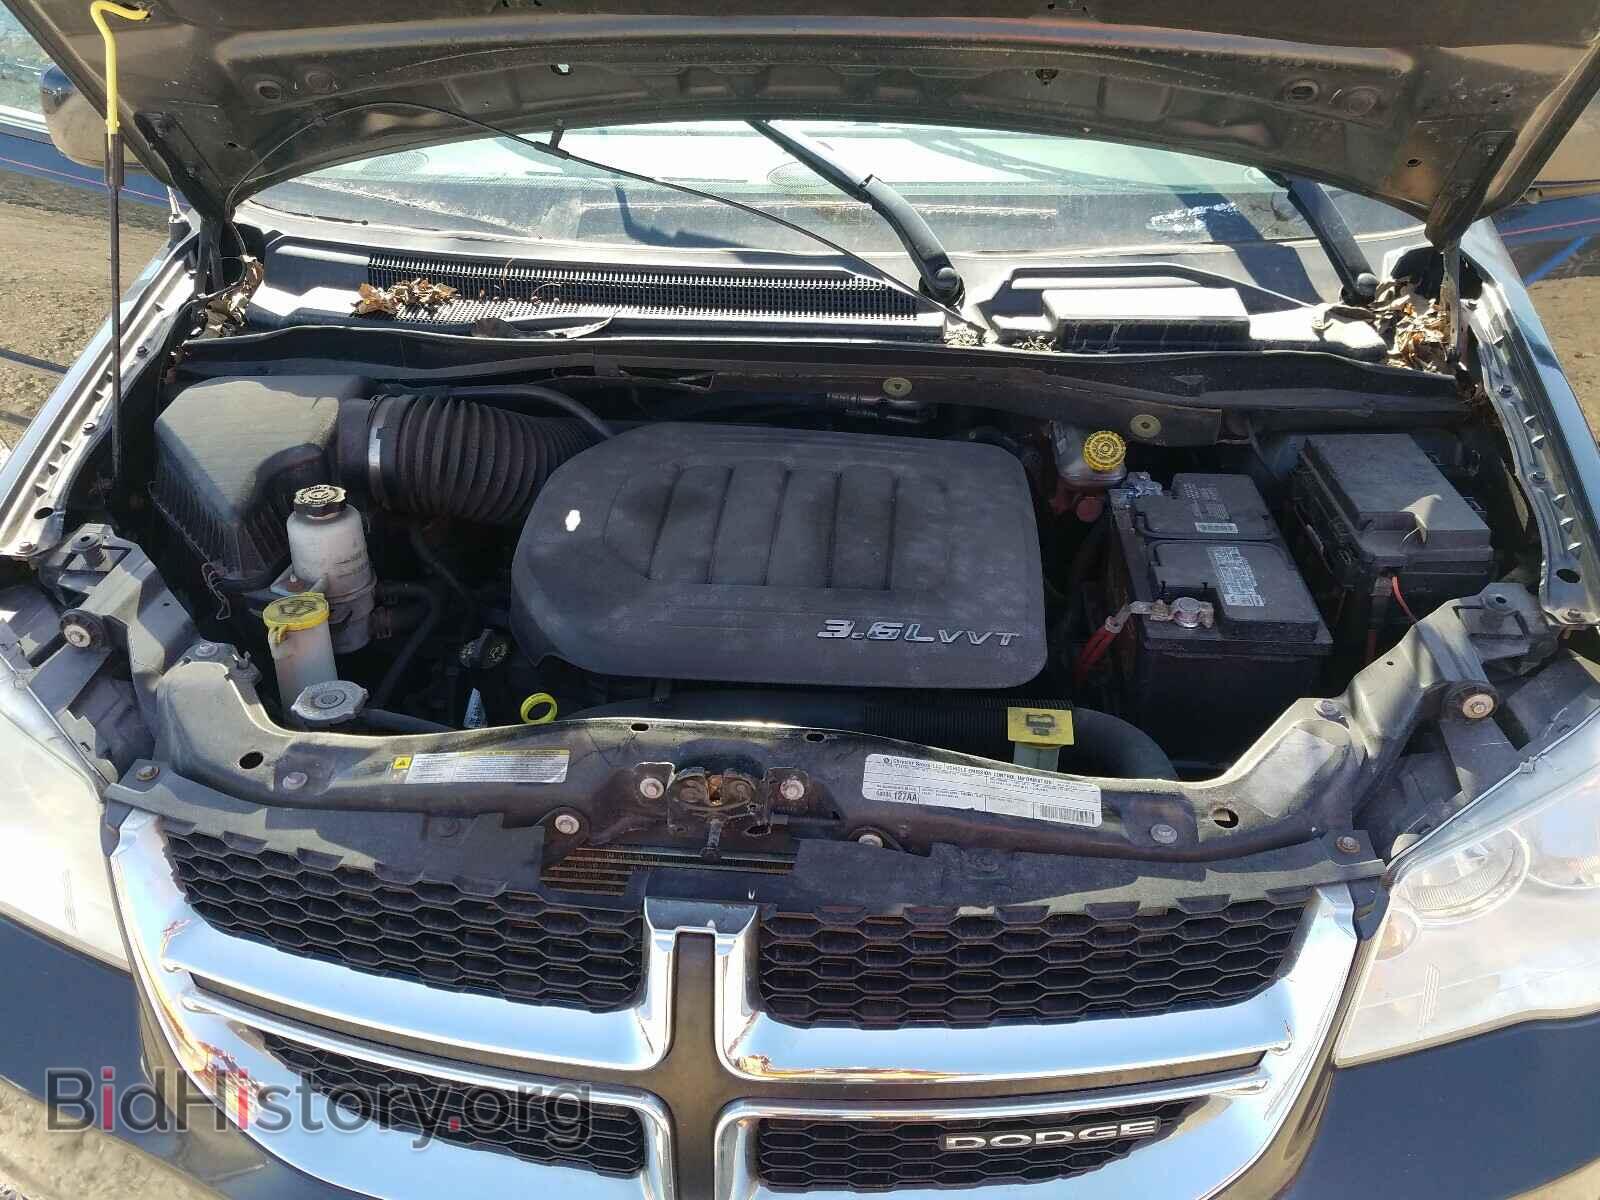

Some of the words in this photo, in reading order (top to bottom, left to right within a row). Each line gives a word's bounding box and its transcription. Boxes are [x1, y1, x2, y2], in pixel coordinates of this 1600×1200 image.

[816, 618, 935, 642] 3.6L
[938, 628, 1020, 647] VVT
[946, 1119, 1157, 1150] DODGE
